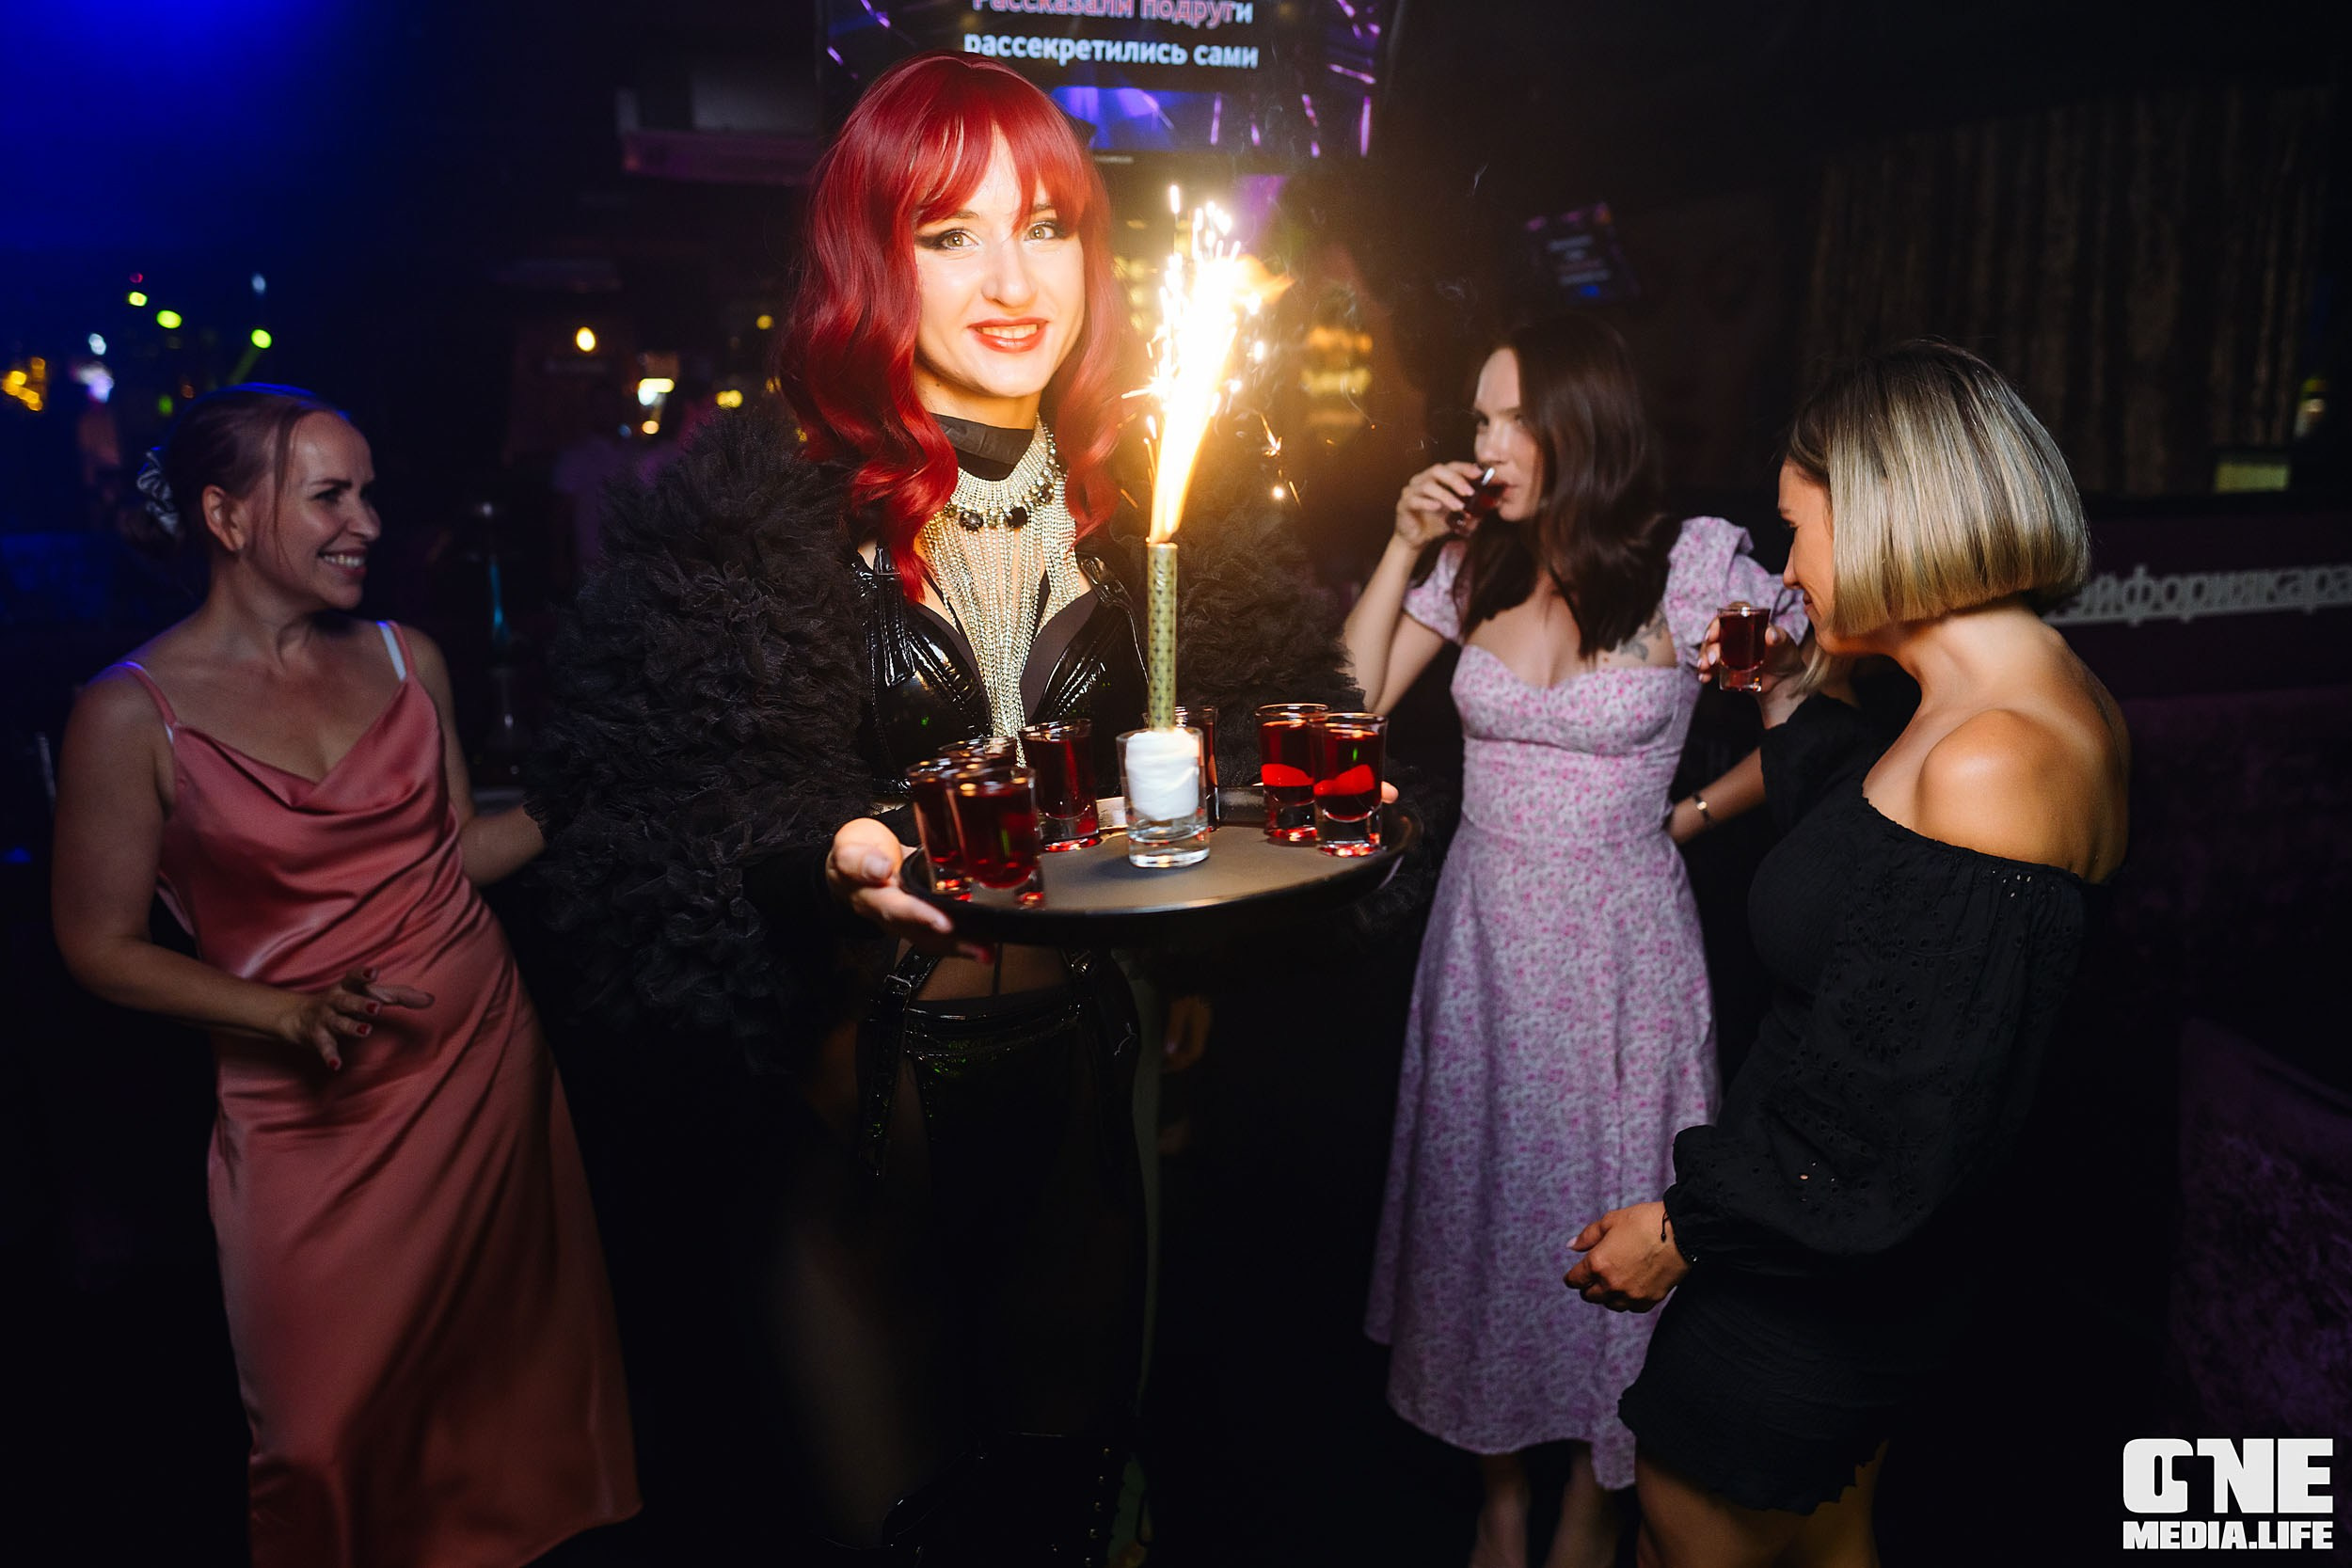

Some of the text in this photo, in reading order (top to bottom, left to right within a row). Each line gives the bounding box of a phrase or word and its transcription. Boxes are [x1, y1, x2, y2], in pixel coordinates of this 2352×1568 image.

[1140, 0, 1253, 29] подруги
[964, 33, 1259, 69] рассекретились сами
